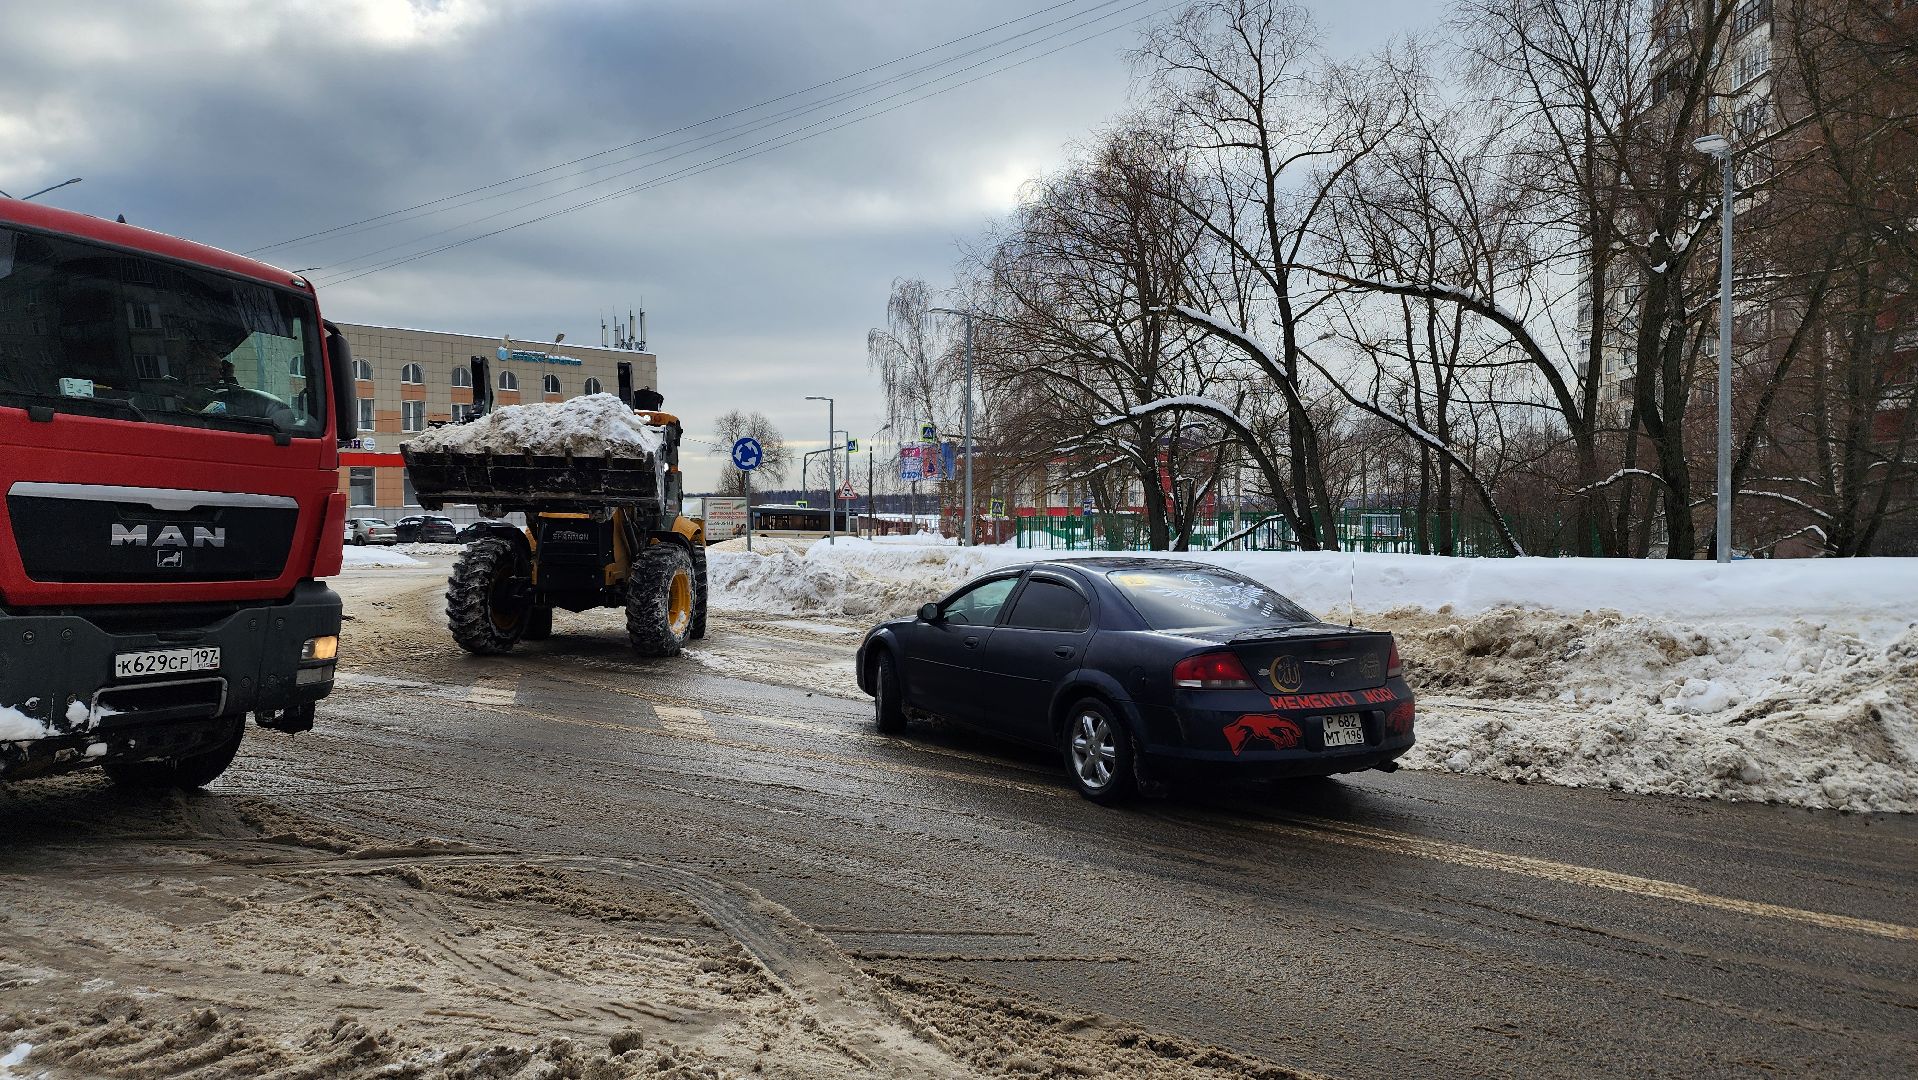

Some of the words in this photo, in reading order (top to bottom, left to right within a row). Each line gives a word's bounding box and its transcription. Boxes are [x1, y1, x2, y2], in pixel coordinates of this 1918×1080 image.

[111, 523, 226, 548] MAN
[121, 654, 189, 674] К629СР
[193, 650, 217, 663] 197
[1269, 692, 1357, 710] MEMENTO
[1361, 687, 1399, 704] MORI
[1326, 716, 1334, 729] Р
[1338, 714, 1357, 728] 682
[1325, 731, 1340, 744] МТ
[1346, 730, 1362, 740] 196
